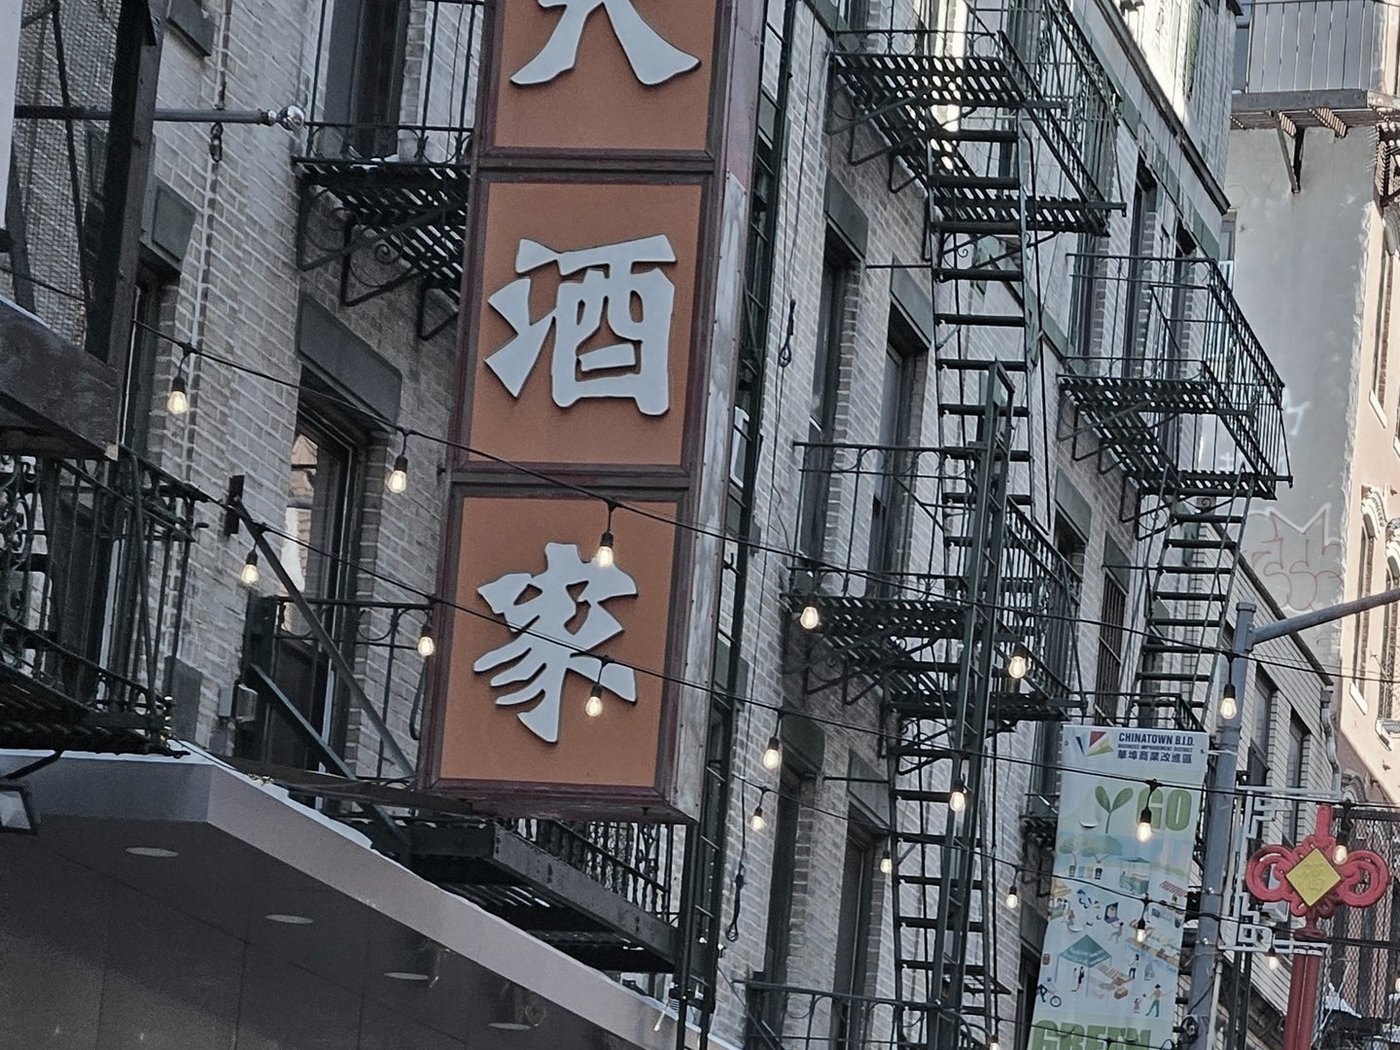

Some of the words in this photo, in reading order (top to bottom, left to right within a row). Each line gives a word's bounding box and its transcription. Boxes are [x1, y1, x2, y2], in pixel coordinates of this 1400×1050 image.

[1118, 732, 1173, 745] CHINATOWN
[1175, 735, 1195, 746] B.I.D.
[1137, 787, 1192, 832] GO
